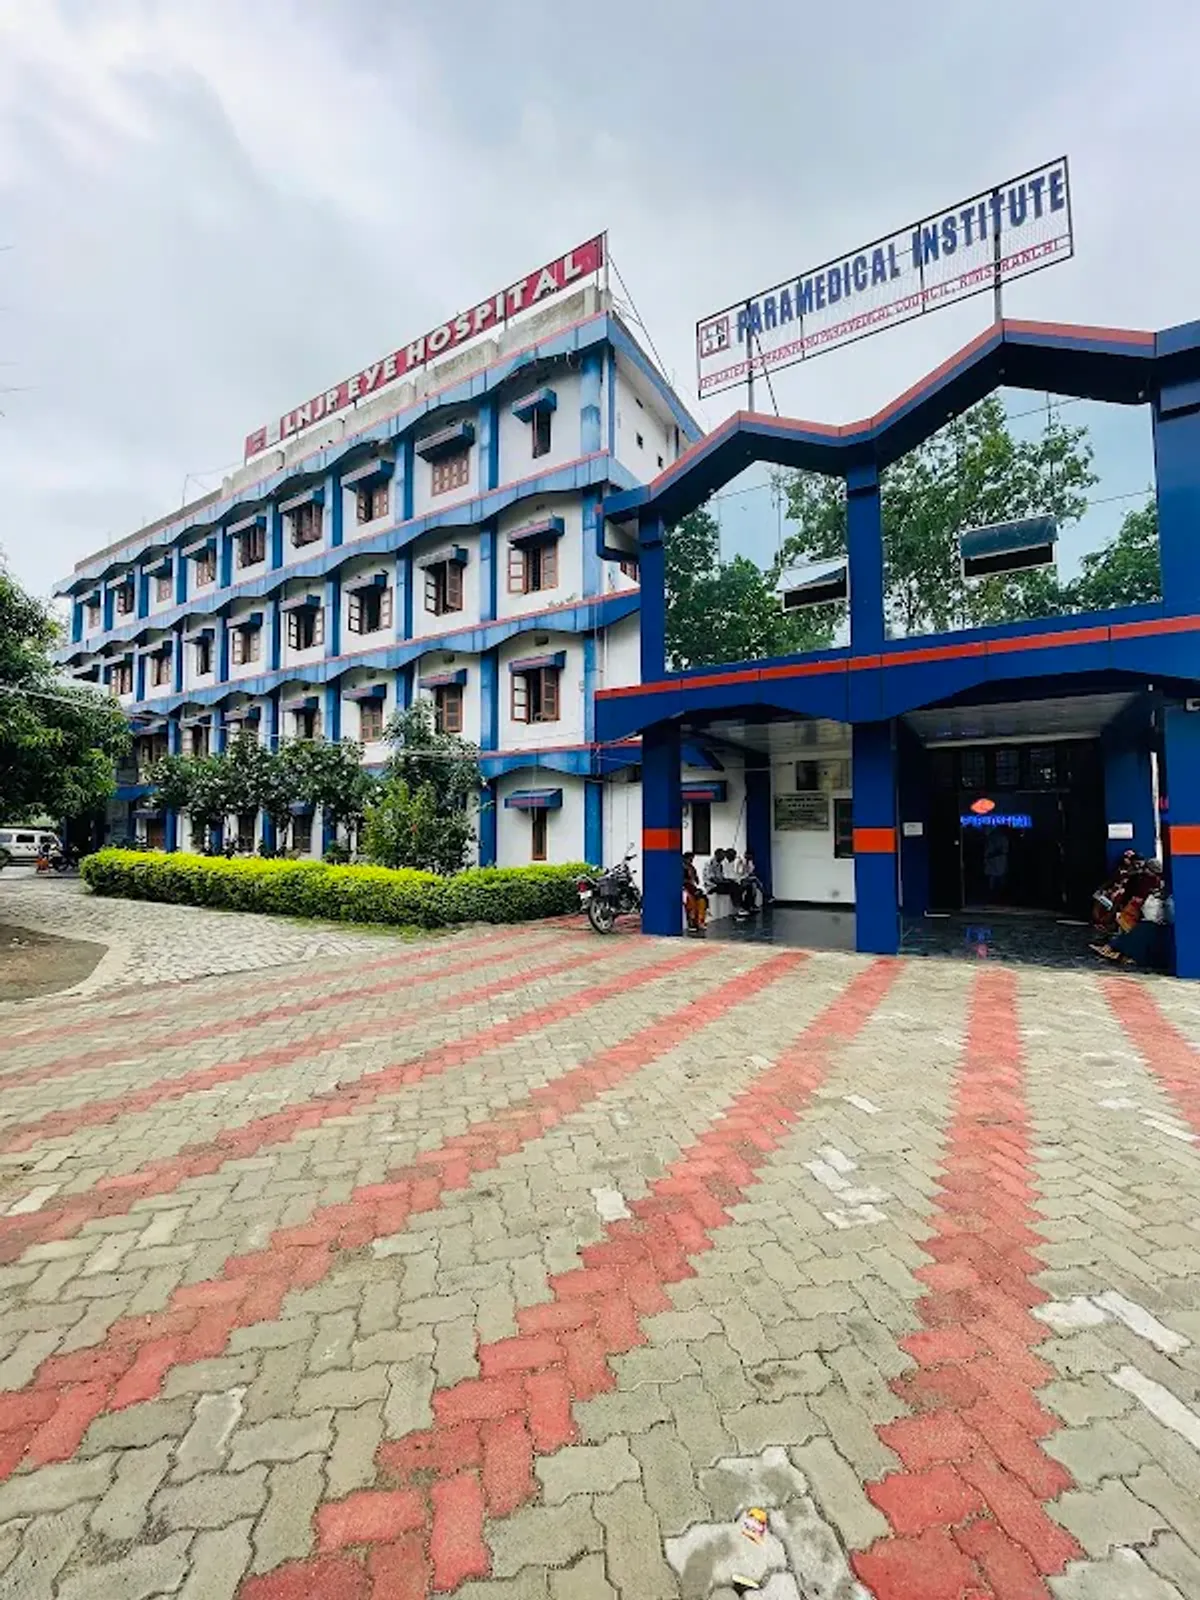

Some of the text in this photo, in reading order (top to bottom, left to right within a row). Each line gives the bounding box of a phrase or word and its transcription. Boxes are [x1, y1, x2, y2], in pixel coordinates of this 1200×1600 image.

[736, 169, 1065, 342] PARAMEDICAL INSTITUTE
[1001, 239, 1059, 271] RANCHI
[284, 252, 583, 435] LNJP EYE HOSPITAL
